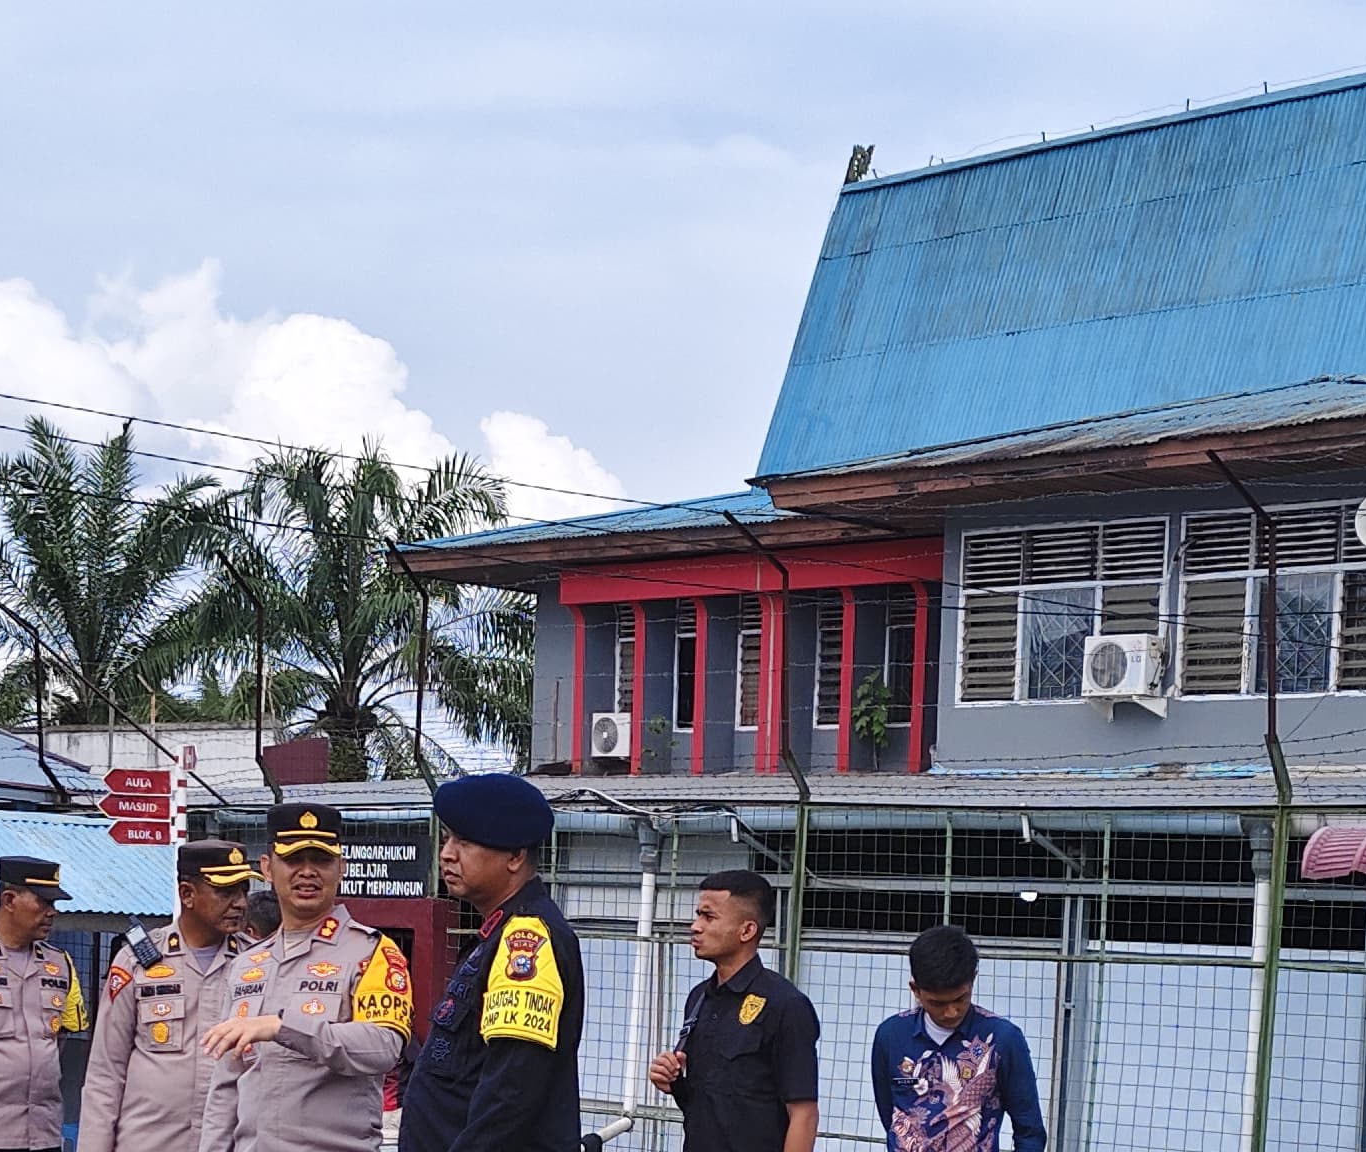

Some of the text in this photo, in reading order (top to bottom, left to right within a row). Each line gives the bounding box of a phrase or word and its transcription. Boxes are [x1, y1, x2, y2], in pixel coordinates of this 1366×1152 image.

[125, 777, 152, 788] AULA
[118, 801, 157, 813] MASJID
[155, 830, 162, 840] B
[366, 881, 423, 896] MEMBANGUN
[509, 931, 539, 942] POLDA
[299, 980, 339, 992] POLRI
[524, 991, 556, 1016] TINDAK
[504, 1010, 519, 1024] LK
[523, 1013, 551, 1033] 2024
